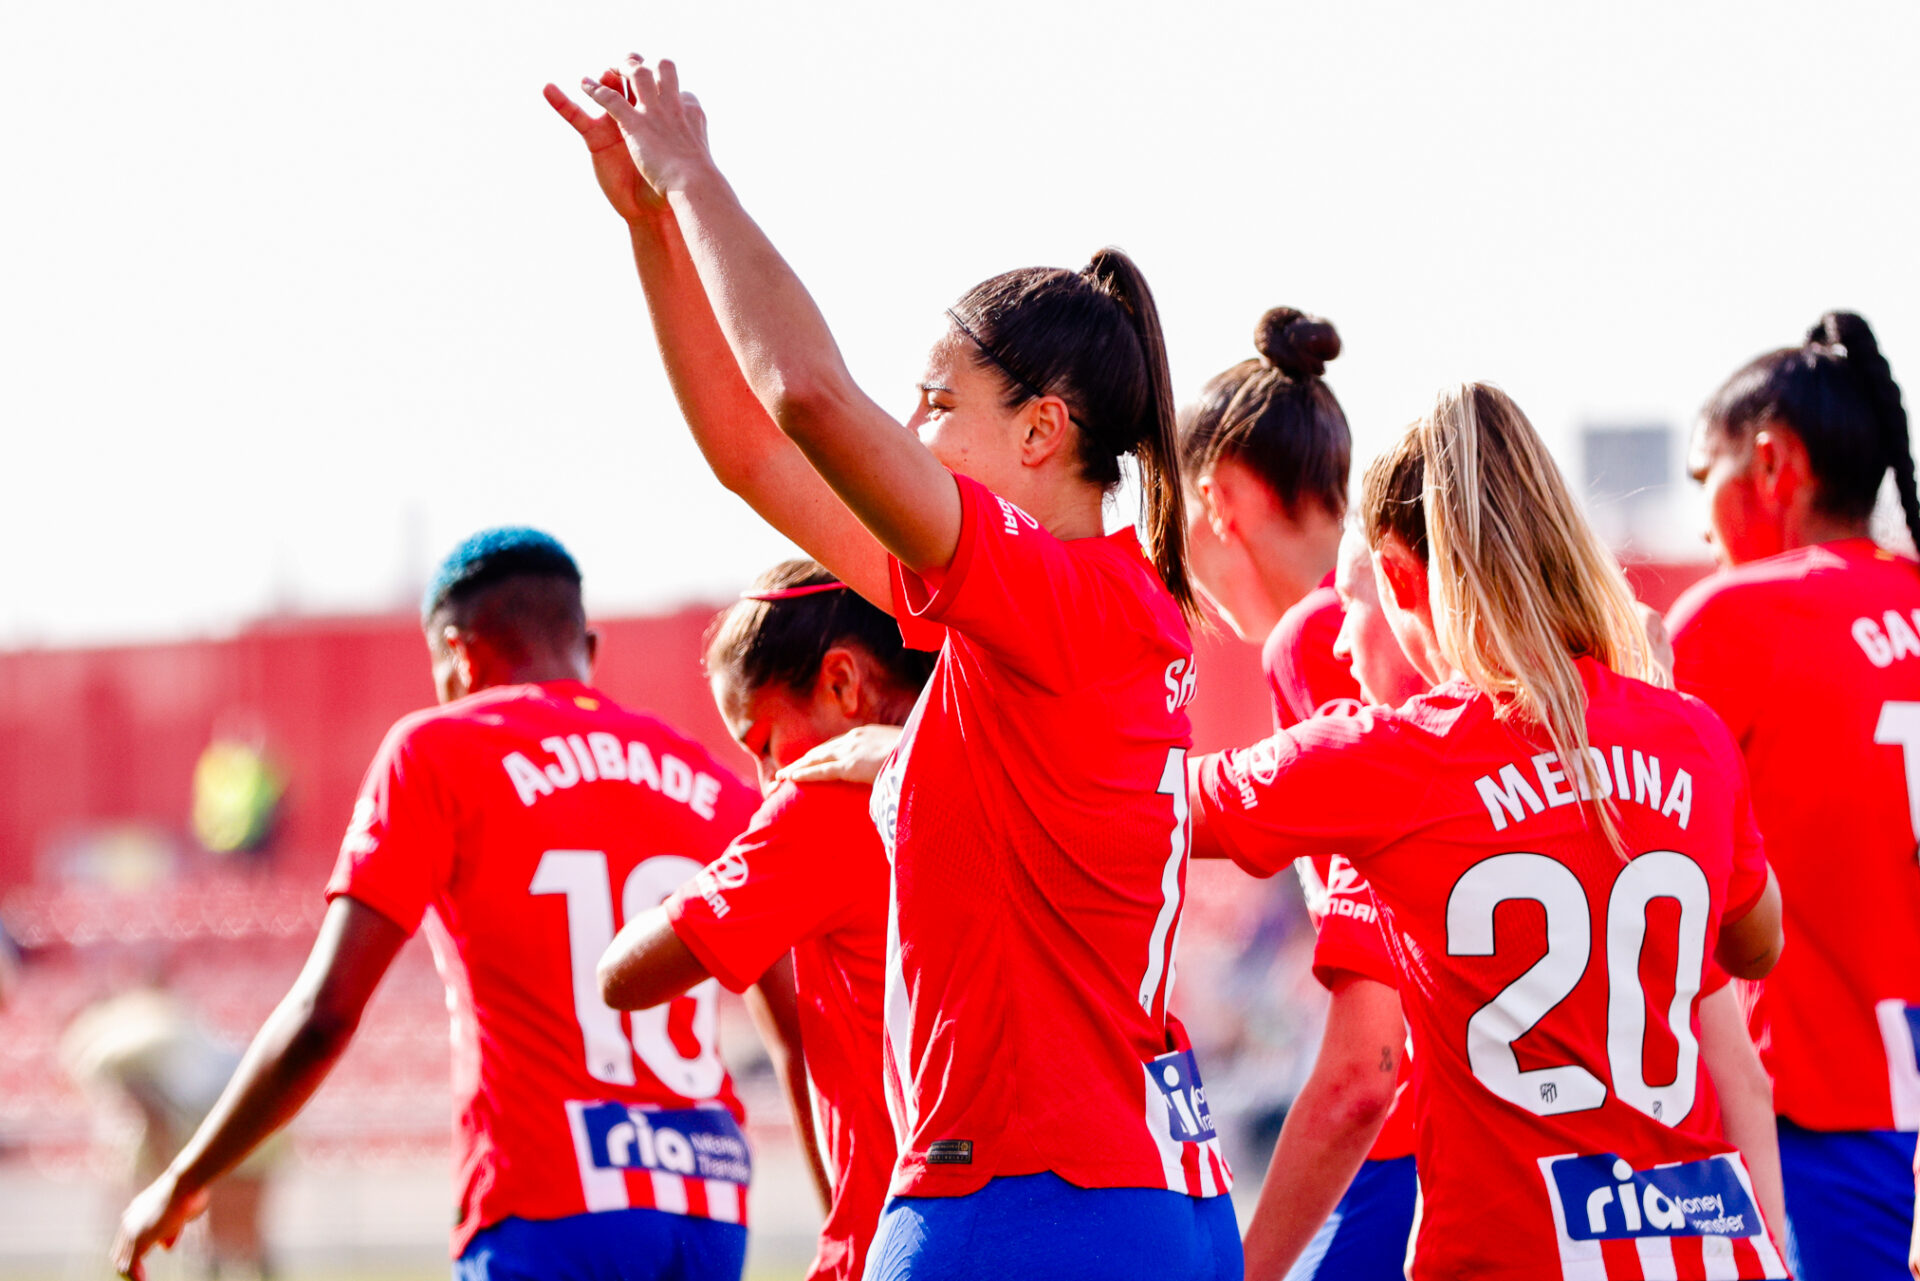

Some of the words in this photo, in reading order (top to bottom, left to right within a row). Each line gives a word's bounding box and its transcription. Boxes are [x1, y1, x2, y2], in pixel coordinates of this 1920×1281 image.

[1164, 653, 1198, 714] SH
[502, 732, 722, 821] AJIBADE
[1474, 745, 1692, 832] MEDINA
[1446, 850, 1710, 1128] 20
[606, 1111, 696, 1175] ria
[1586, 1158, 1686, 1234] ria
